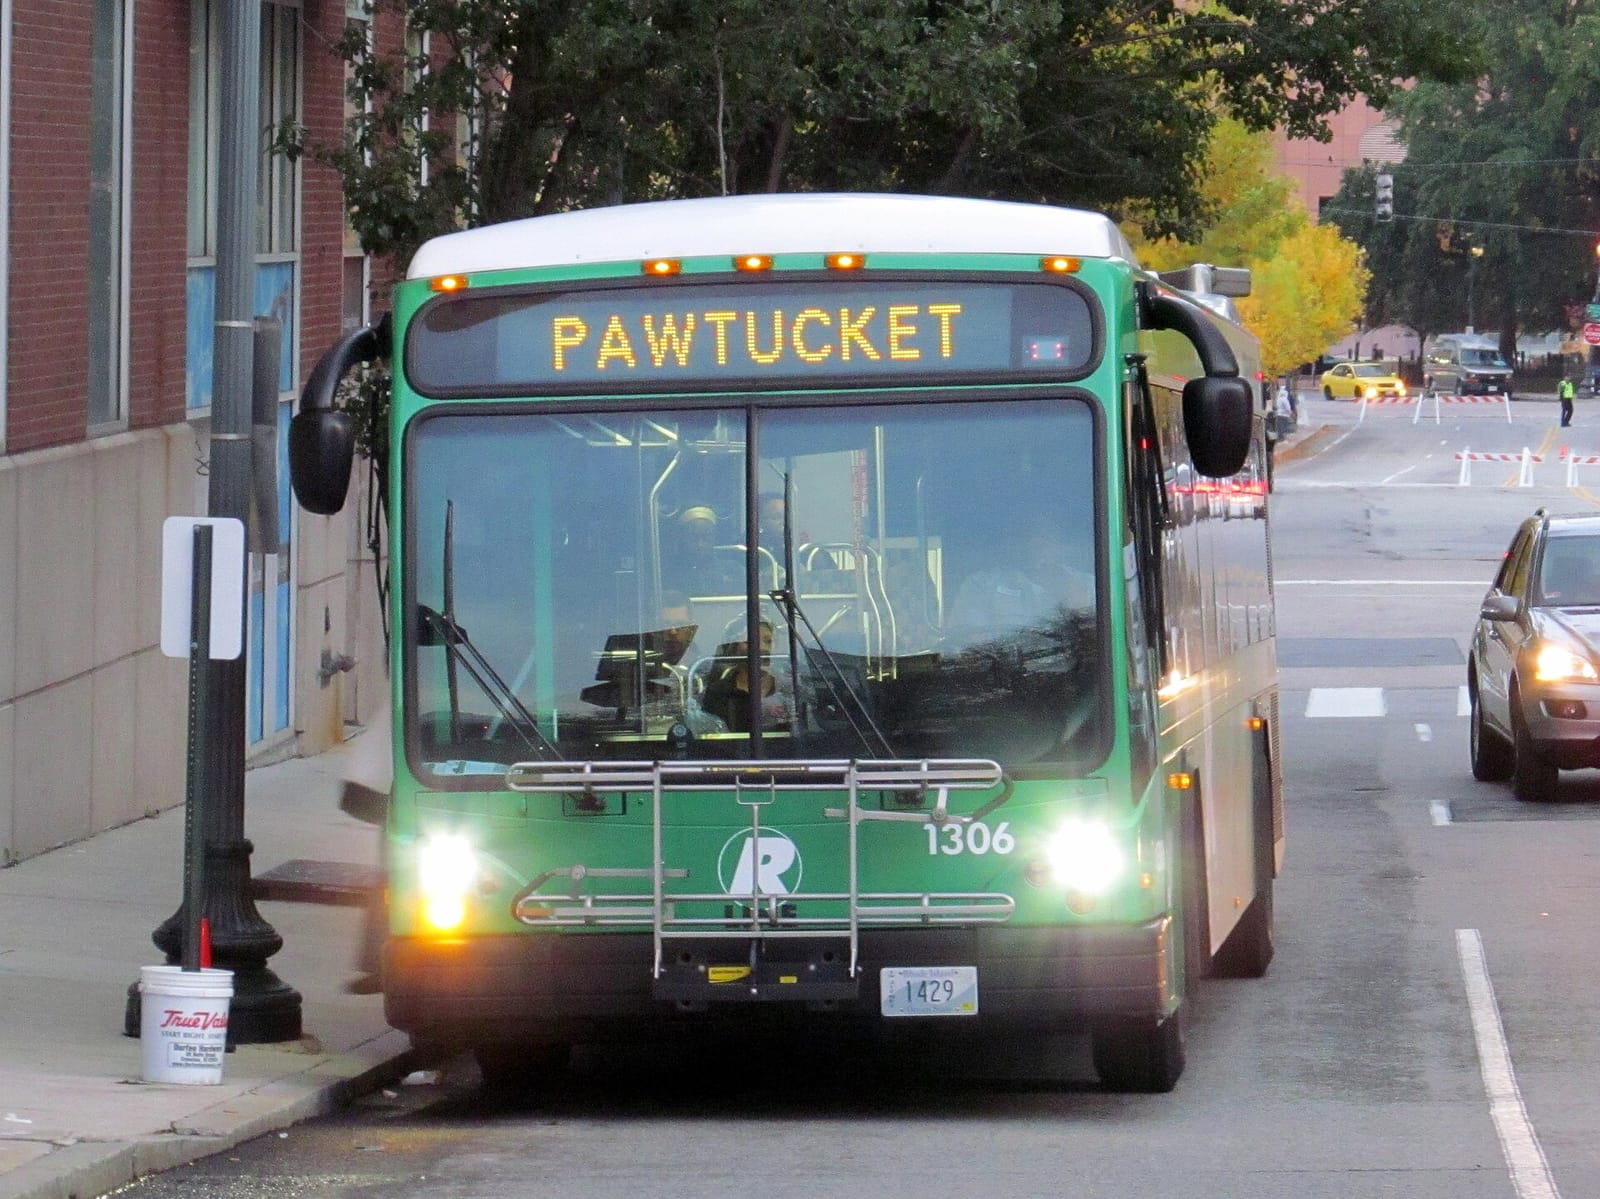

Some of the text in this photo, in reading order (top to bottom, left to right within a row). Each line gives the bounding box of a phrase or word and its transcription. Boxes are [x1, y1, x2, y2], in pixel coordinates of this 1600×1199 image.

[552, 303, 963, 371] PAWTUCKET
[923, 821, 1015, 856] 1306
[906, 979, 954, 1003] 1429
